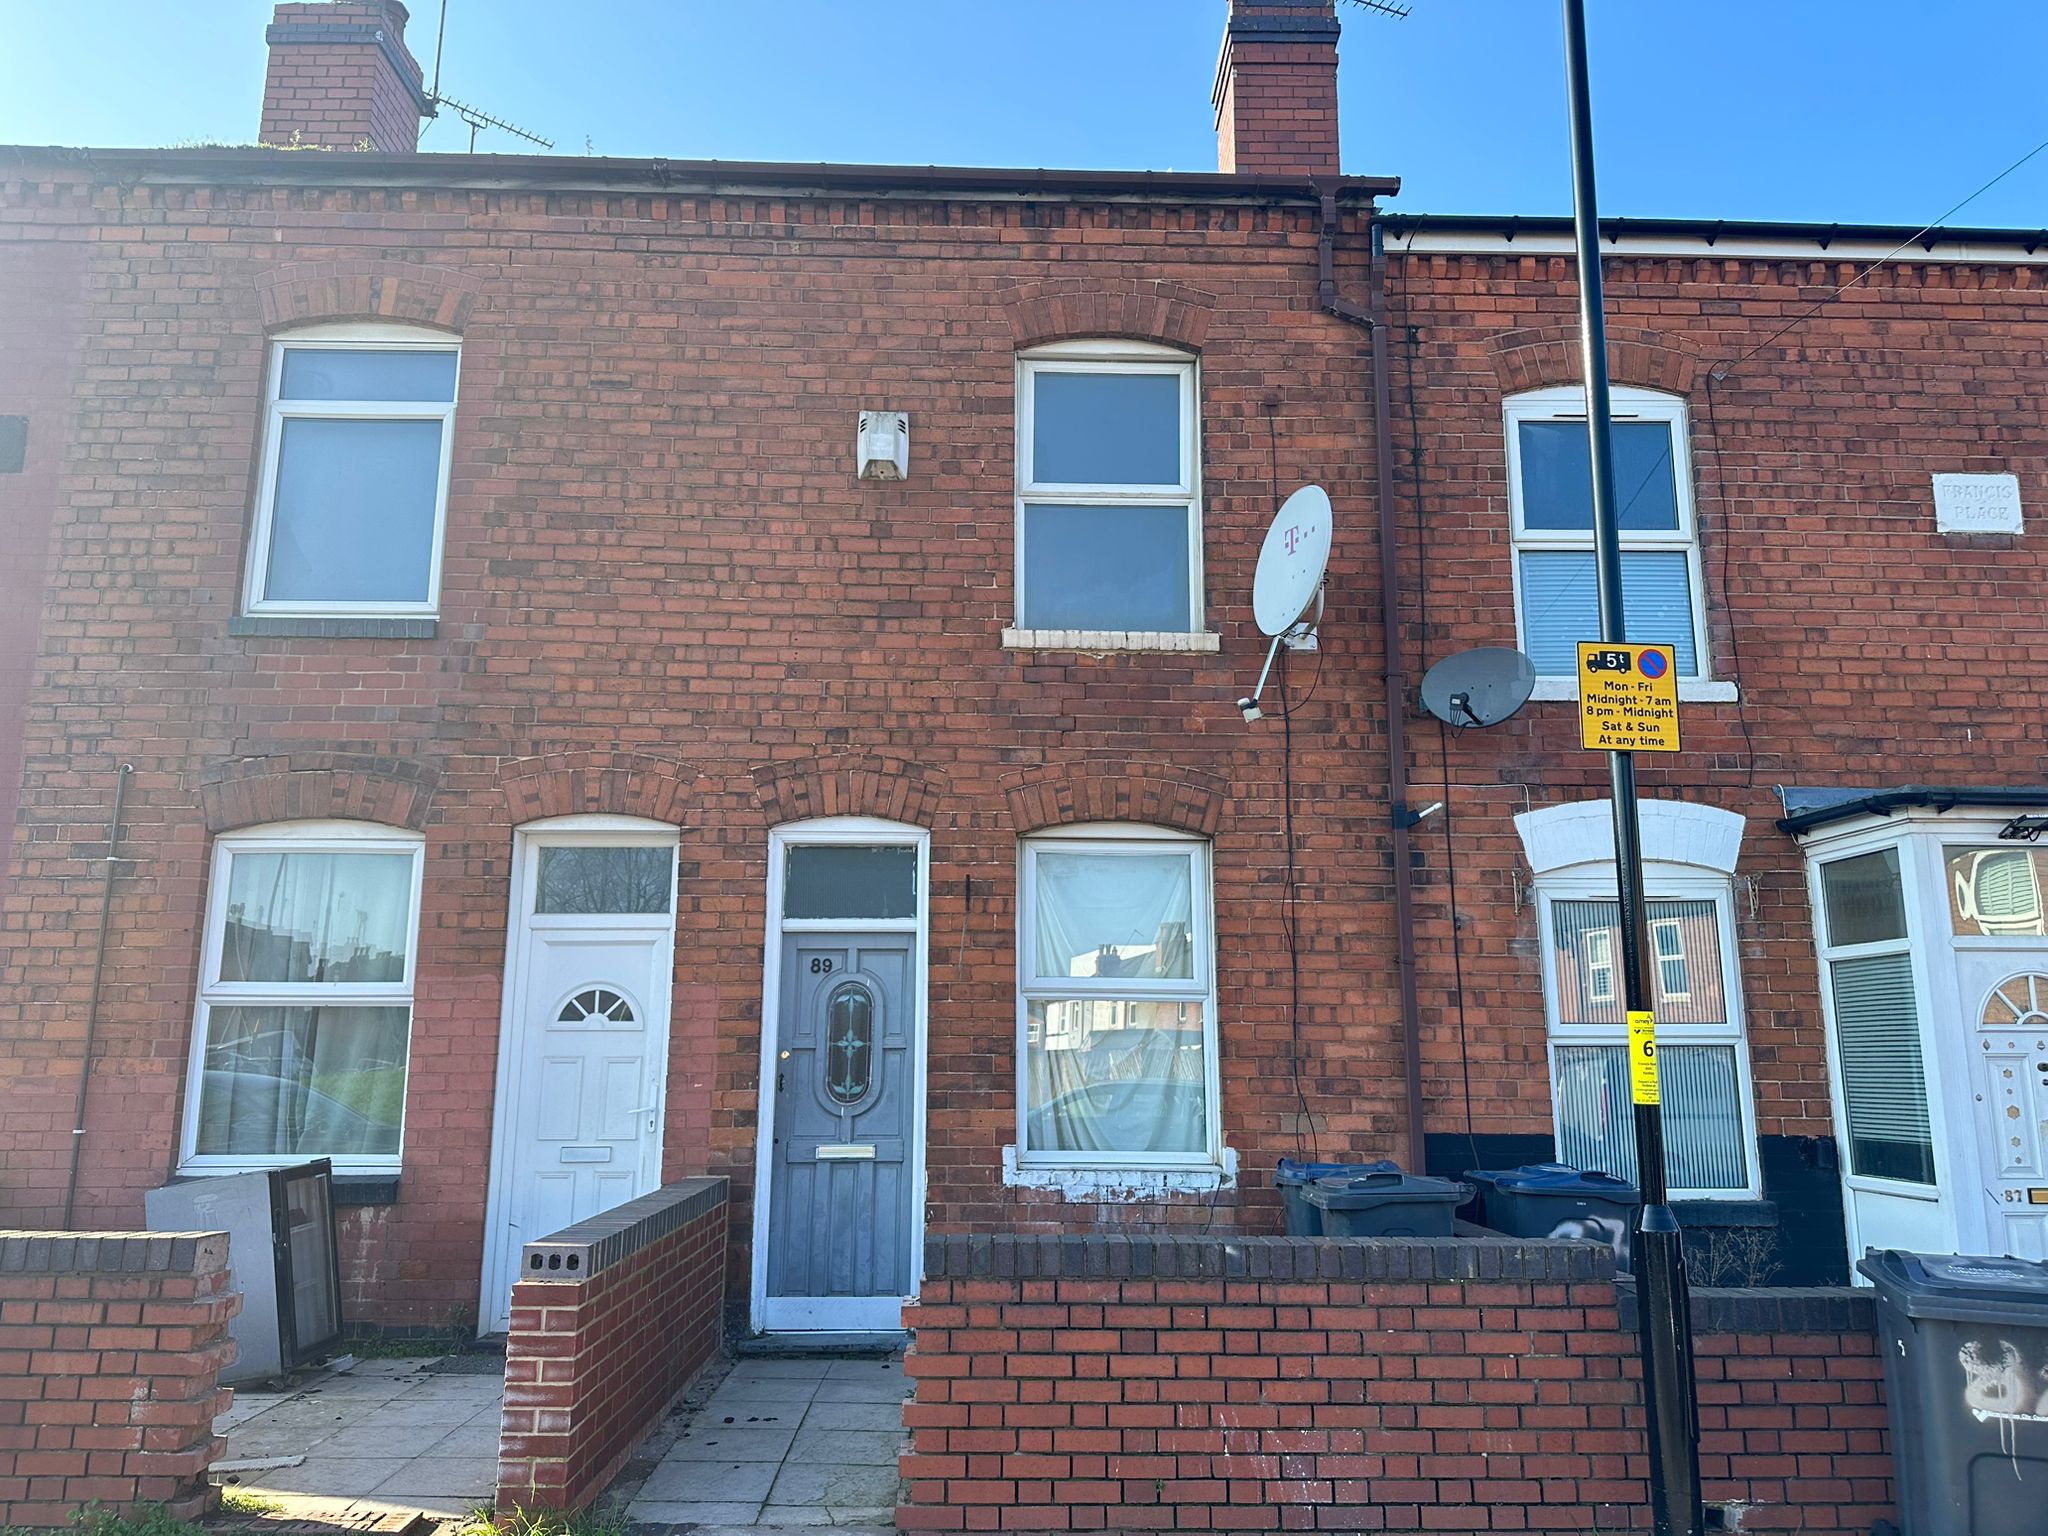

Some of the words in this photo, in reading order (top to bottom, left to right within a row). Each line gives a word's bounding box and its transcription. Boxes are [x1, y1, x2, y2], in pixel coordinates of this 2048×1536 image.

[1955, 506, 2009, 520] PLACE
[1604, 681, 1628, 691] Mon
[1638, 682, 1653, 692] Fri
[1587, 694, 1637, 706] Midnight
[1623, 707, 1674, 719] Midnight
[1602, 721, 1622, 731] Sat
[1626, 722, 1634, 731] &
[1638, 722, 1660, 732] Sun
[1599, 735, 1612, 744] At
[1616, 737, 1636, 747] any
[1640, 735, 1665, 746] time
[810, 958, 832, 974] 89
[1643, 1040, 1654, 1057] 6
